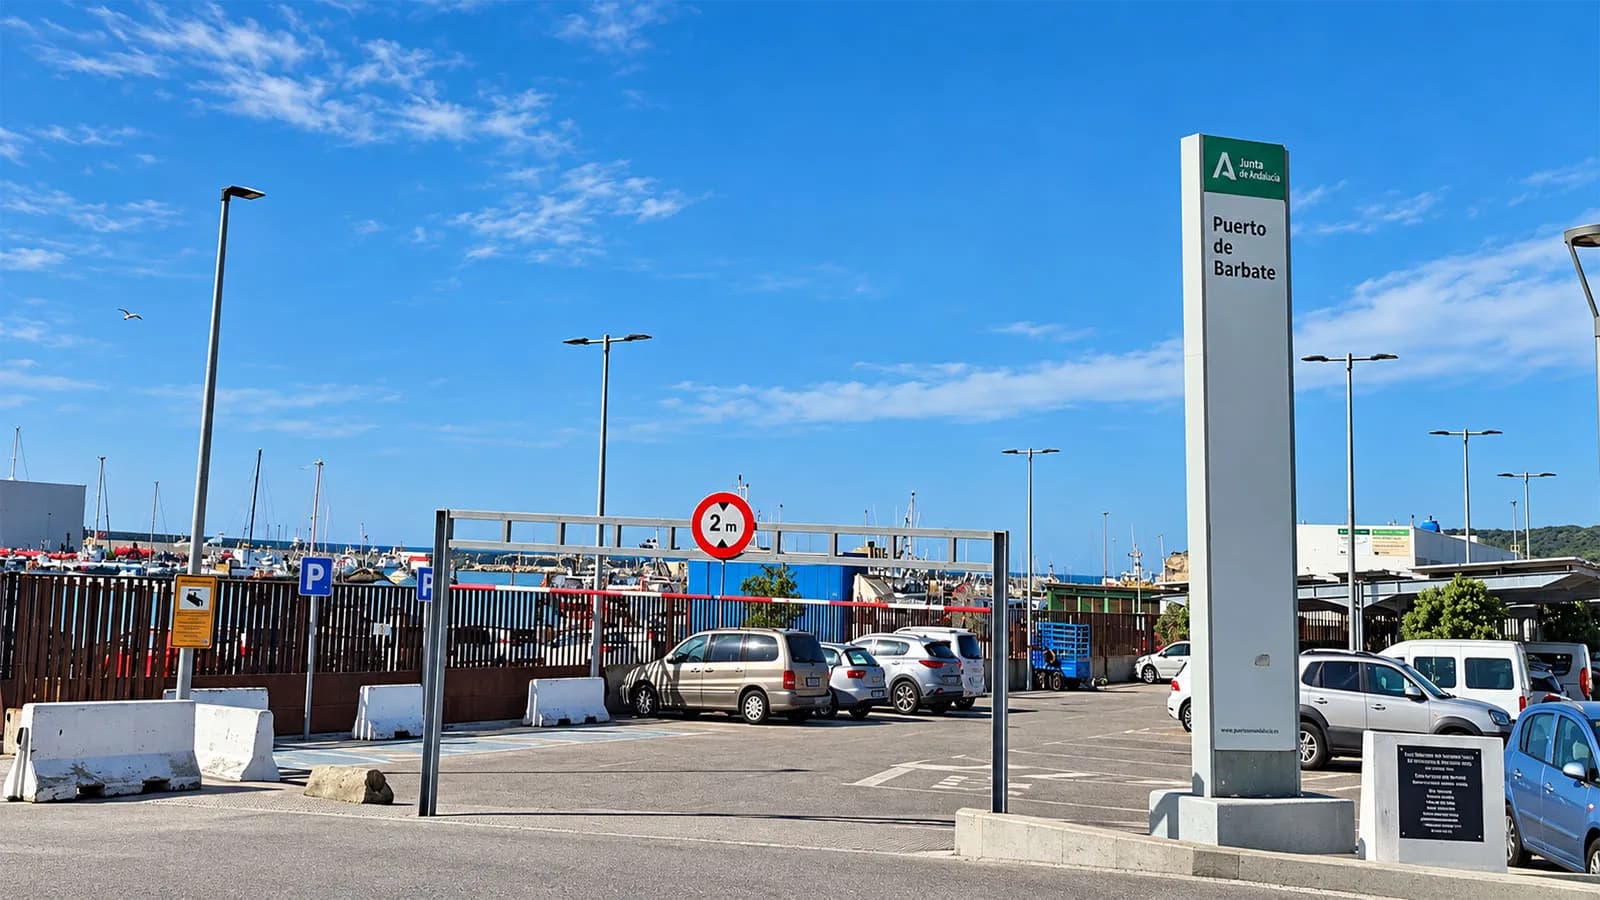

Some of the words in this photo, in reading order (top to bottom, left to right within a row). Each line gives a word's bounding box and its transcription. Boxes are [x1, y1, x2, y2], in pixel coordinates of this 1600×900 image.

[1239, 157, 1264, 170] Junta
[1239, 169, 1248, 179] de
[1213, 216, 1266, 236] Puerto
[1213, 238, 1233, 255] de
[1214, 260, 1276, 280] Barbate
[709, 514, 721, 532] 2
[725, 522, 737, 533] m
[306, 563, 325, 591] P
